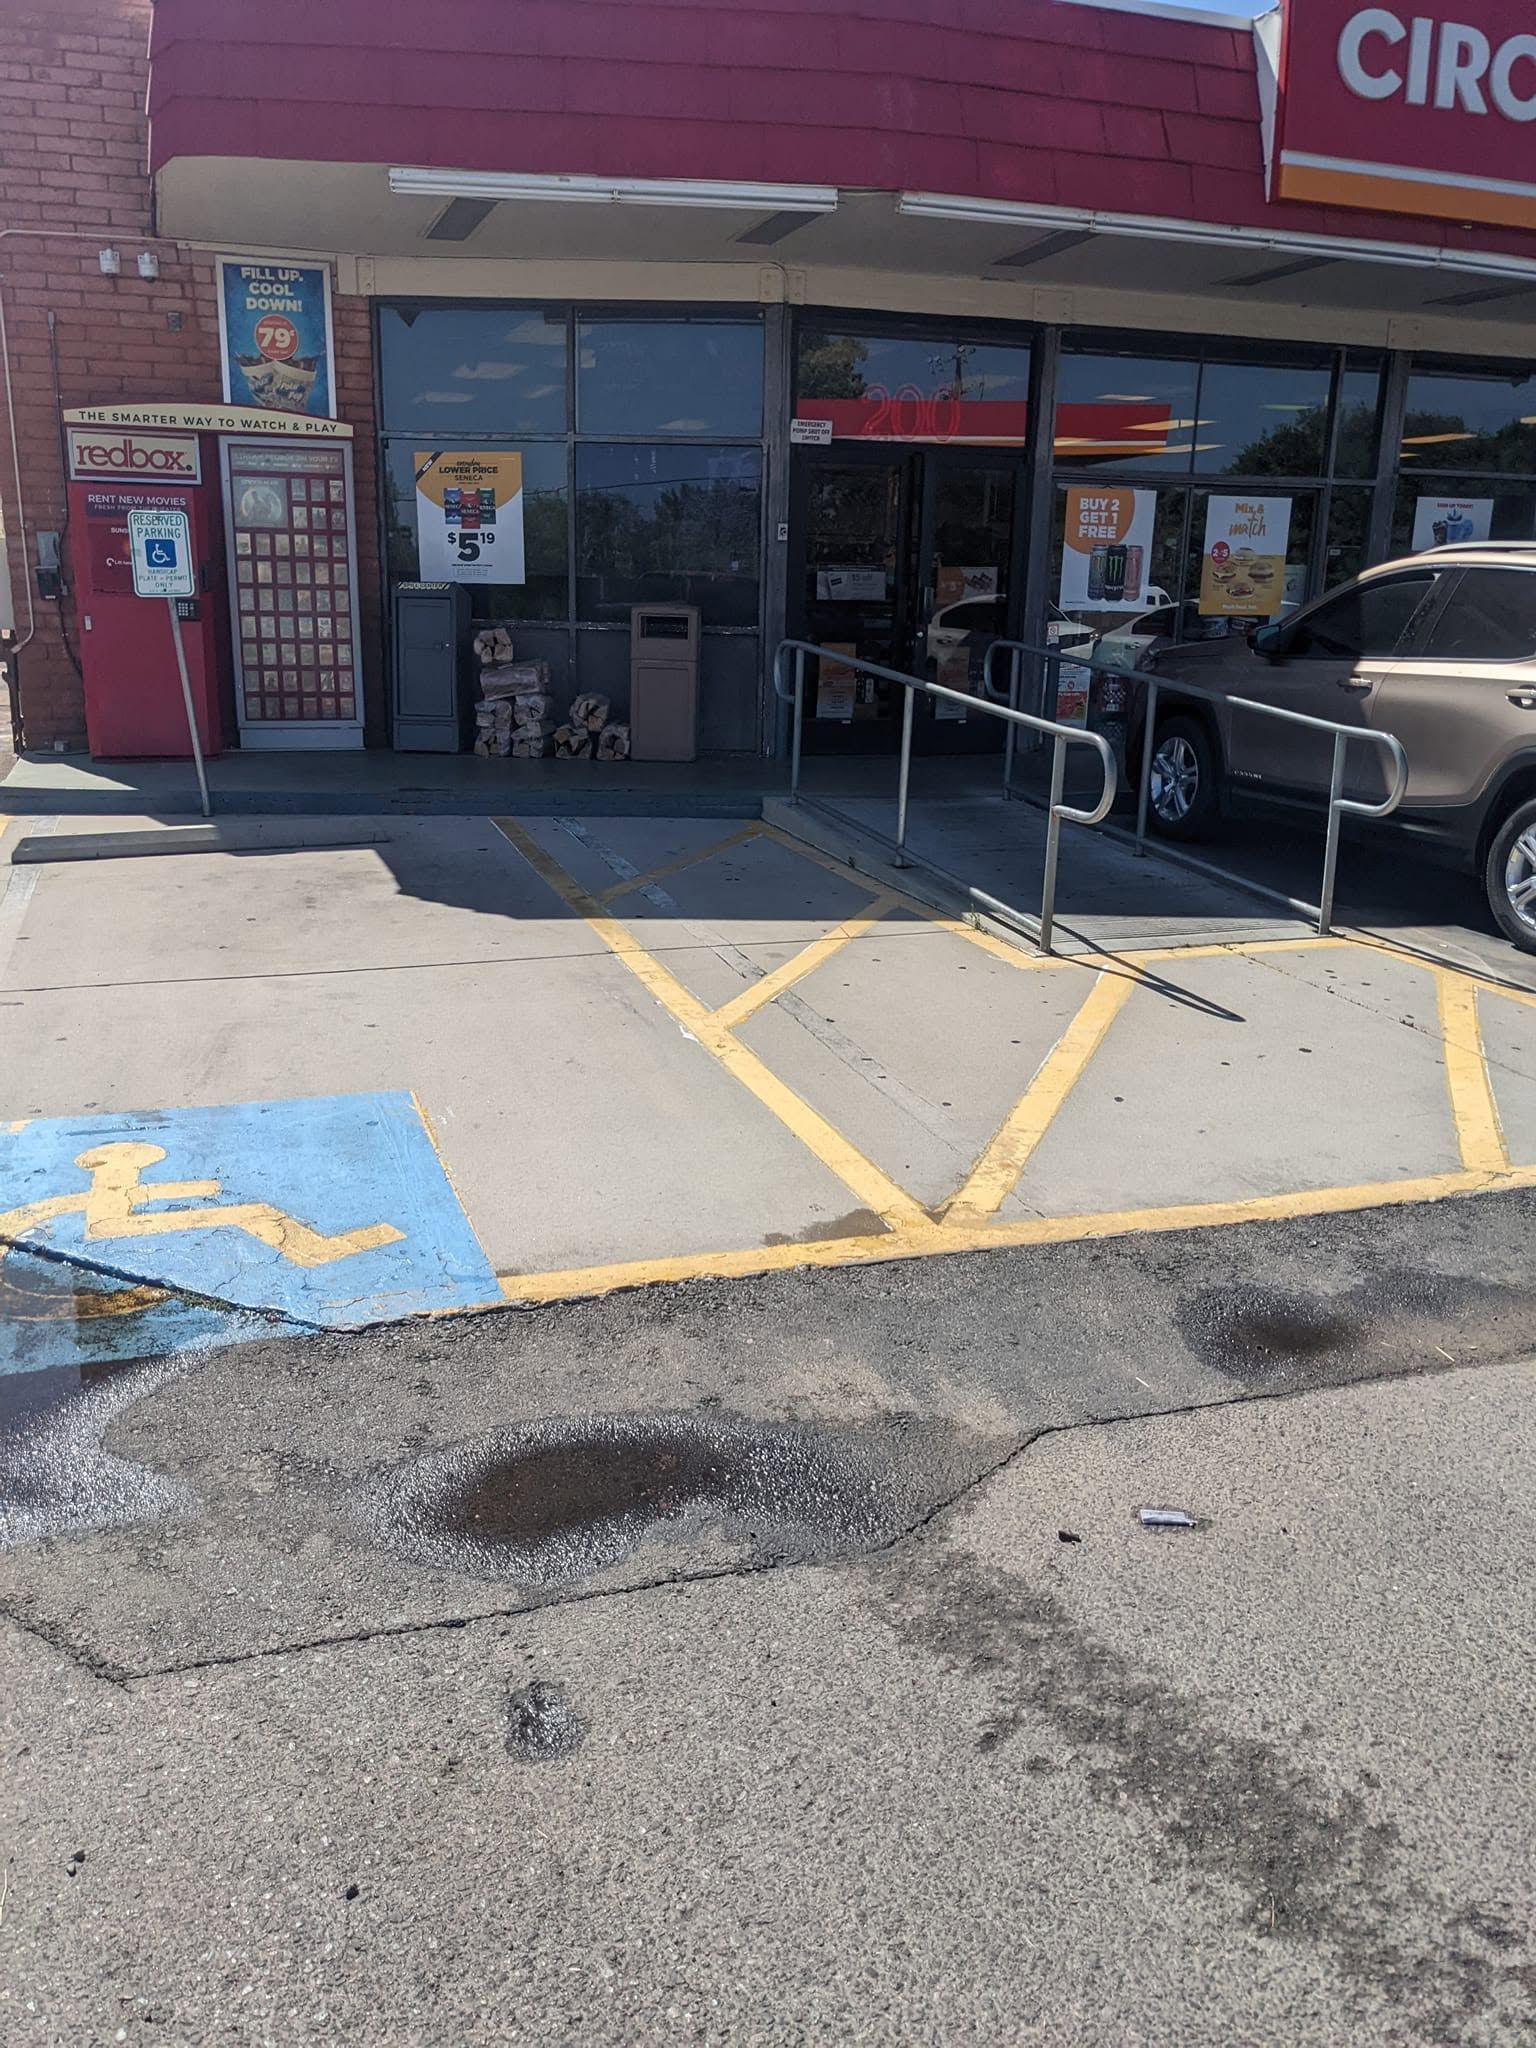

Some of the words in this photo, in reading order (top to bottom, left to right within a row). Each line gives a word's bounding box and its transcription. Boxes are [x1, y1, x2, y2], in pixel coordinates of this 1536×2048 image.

[1337, 8, 1536, 122] CIRC
[240, 267, 275, 280] FILL
[278, 269, 303, 282] UP.
[249, 282, 294, 296] COOL
[246, 298, 302, 312] DOWN!
[859, 384, 961, 443] 200
[79, 411, 105, 421] THE
[112, 412, 177, 425] SMARTER
[183, 416, 212, 426] WAY
[218, 417, 235, 428] TO
[240, 419, 286, 431] WATCH
[292, 422, 299, 431] &
[305, 423, 337, 433] PLAY
[439, 466, 470, 474] LOWER
[473, 466, 498, 474] PRICE
[88, 494, 116, 504] RENT
[119, 495, 144, 504] NEW
[147, 496, 186, 506] MOVIES
[1079, 498, 1109, 510] BUY
[1111, 499, 1120, 511] 2
[133, 514, 182, 526] RESERVED
[1079, 511, 1108, 523] GET
[1111, 512, 1118, 523] 1
[137, 528, 181, 538] PARKING
[1078, 525, 1117, 539] FREE
